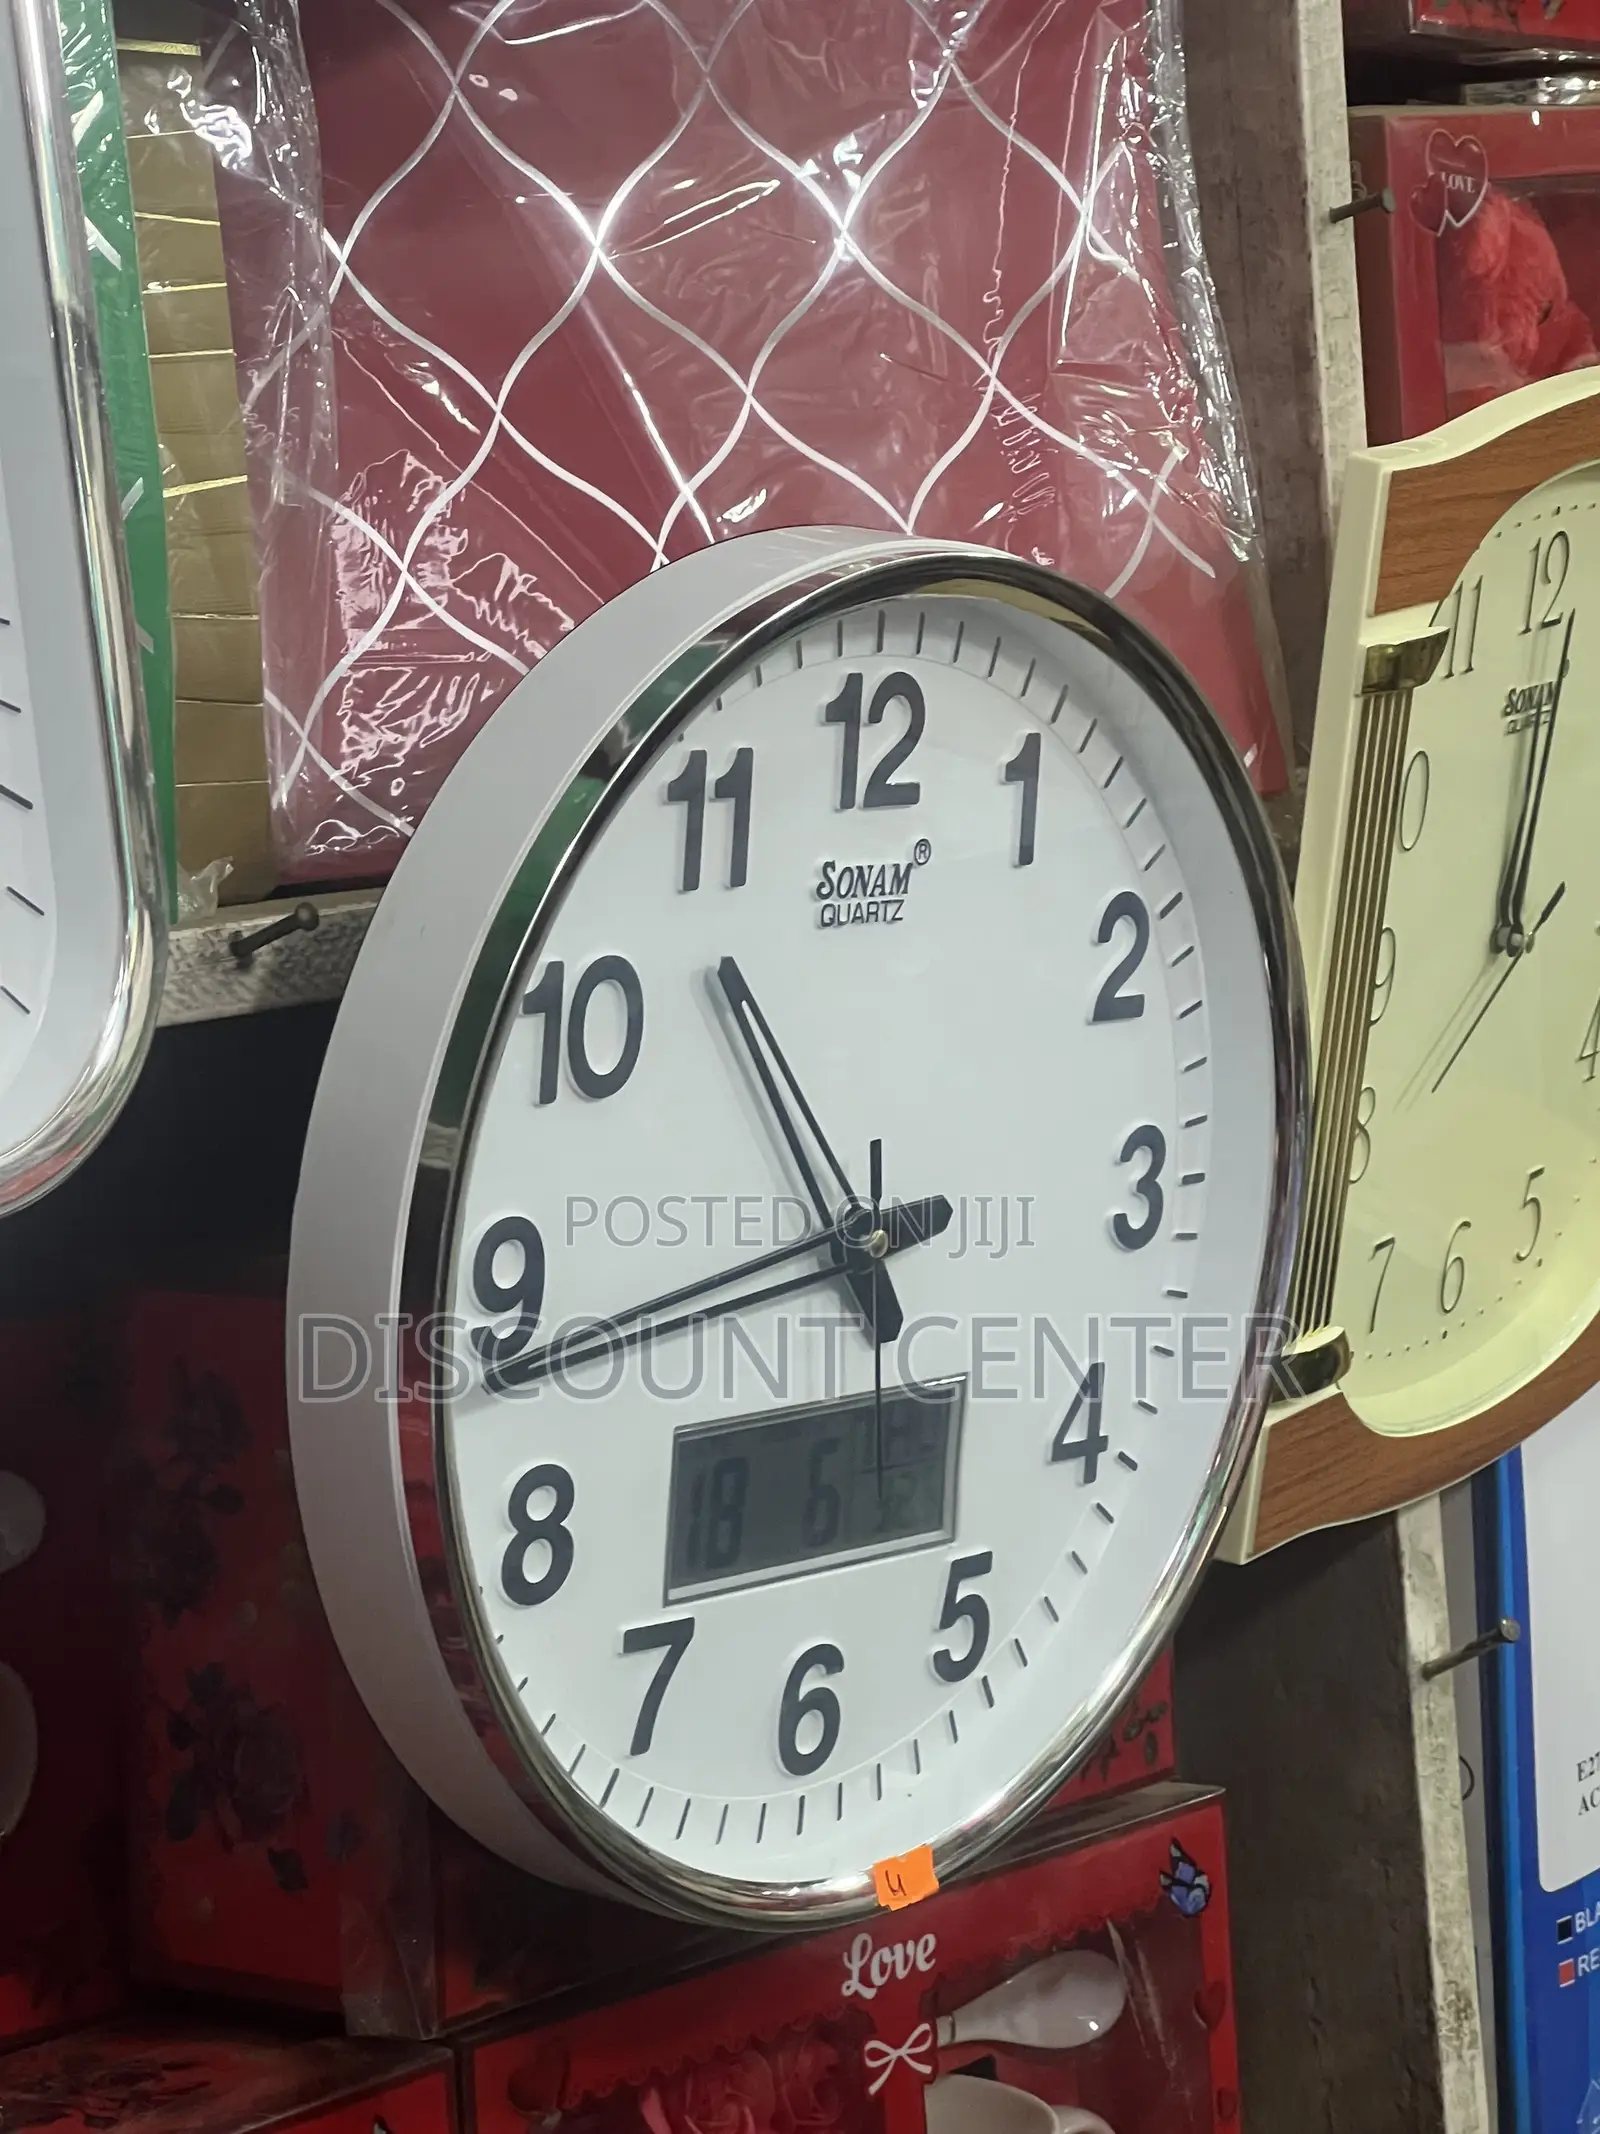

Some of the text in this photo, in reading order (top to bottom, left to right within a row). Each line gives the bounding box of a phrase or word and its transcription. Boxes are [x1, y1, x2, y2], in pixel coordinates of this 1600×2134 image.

[1440, 171, 1476, 194] LOVE
[1442, 575, 1483, 678] 11
[1518, 530, 1570, 635] 12
[824, 671, 926, 811] 12
[1004, 732, 1041, 866] 1
[667, 747, 754, 892] 11
[815, 860, 913, 899] SONAM
[819, 898, 905, 928] QUARTZ
[1092, 891, 1151, 1023] 2
[521, 954, 644, 1106] 10
[1113, 1124, 1167, 1251] 3
[1514, 1166, 1545, 1262] 5
[470, 1215, 546, 1362] 9
[1368, 1237, 1396, 1334] 7
[1440, 1220, 1472, 1314] 6
[1051, 1361, 1109, 1485] 4
[501, 1463, 575, 1607] 8
[932, 1550, 993, 1683] 5
[622, 1616, 696, 1757] 7
[778, 1643, 845, 1776] 6
[841, 1932, 937, 2000] Love
